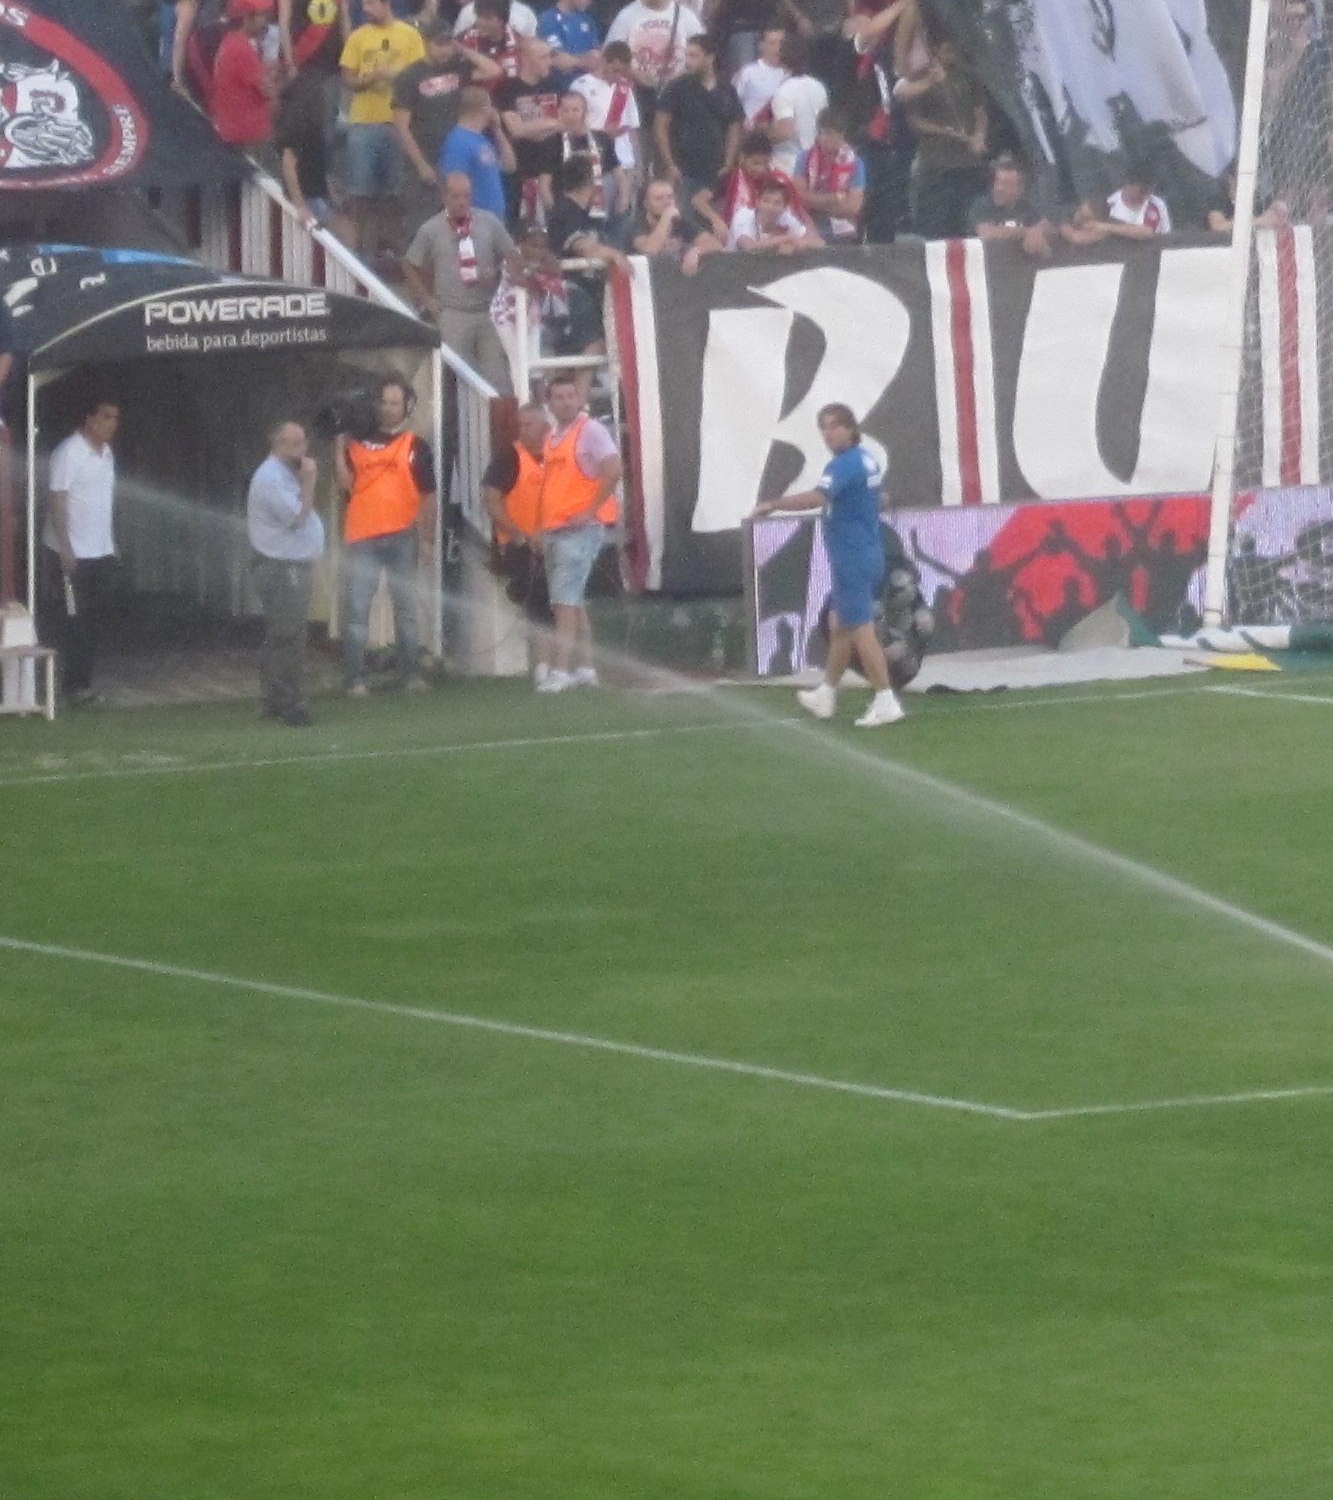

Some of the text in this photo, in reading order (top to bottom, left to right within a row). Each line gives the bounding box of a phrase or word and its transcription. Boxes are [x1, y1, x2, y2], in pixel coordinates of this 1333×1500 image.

[144, 293, 331, 326] POWERADE
[146, 325, 328, 353] bebida para deportistas
